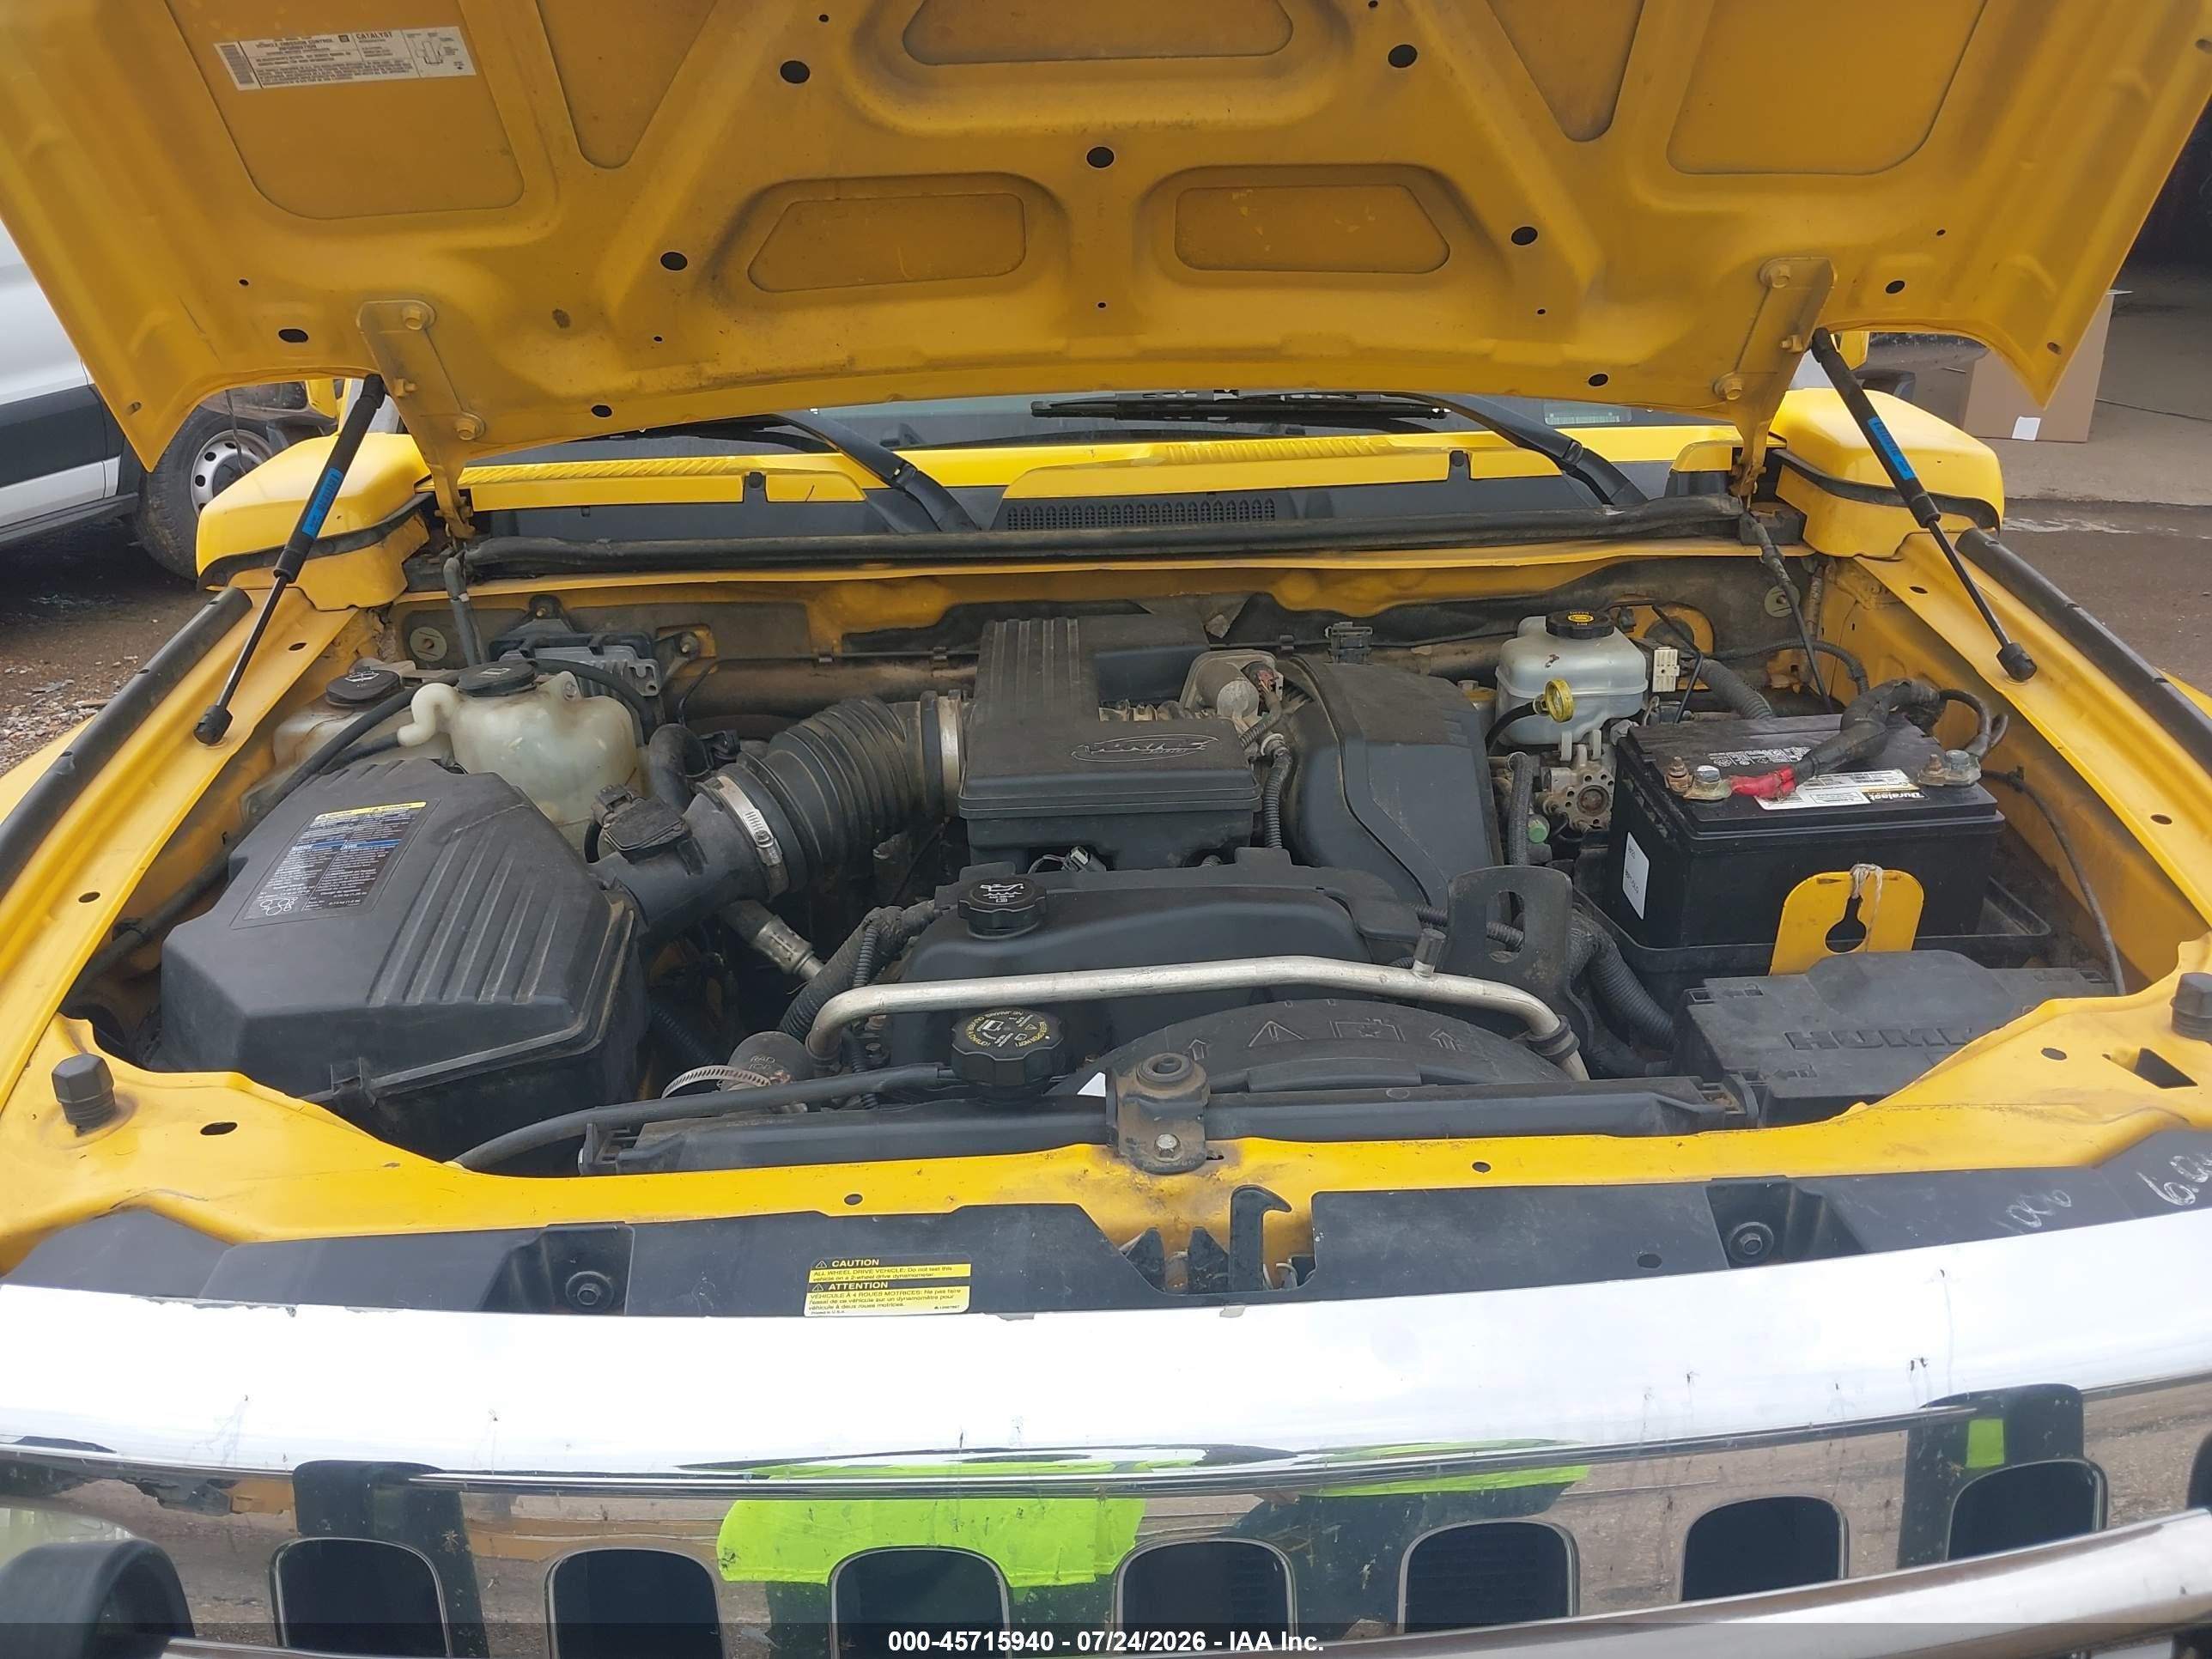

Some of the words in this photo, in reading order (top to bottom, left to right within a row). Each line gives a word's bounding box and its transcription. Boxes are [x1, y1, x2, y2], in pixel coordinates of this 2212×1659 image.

[1869, 793, 1924, 801] Duralast
[831, 1259, 879, 1267] CAUTION
[829, 1282, 889, 1291] ATTENTION
